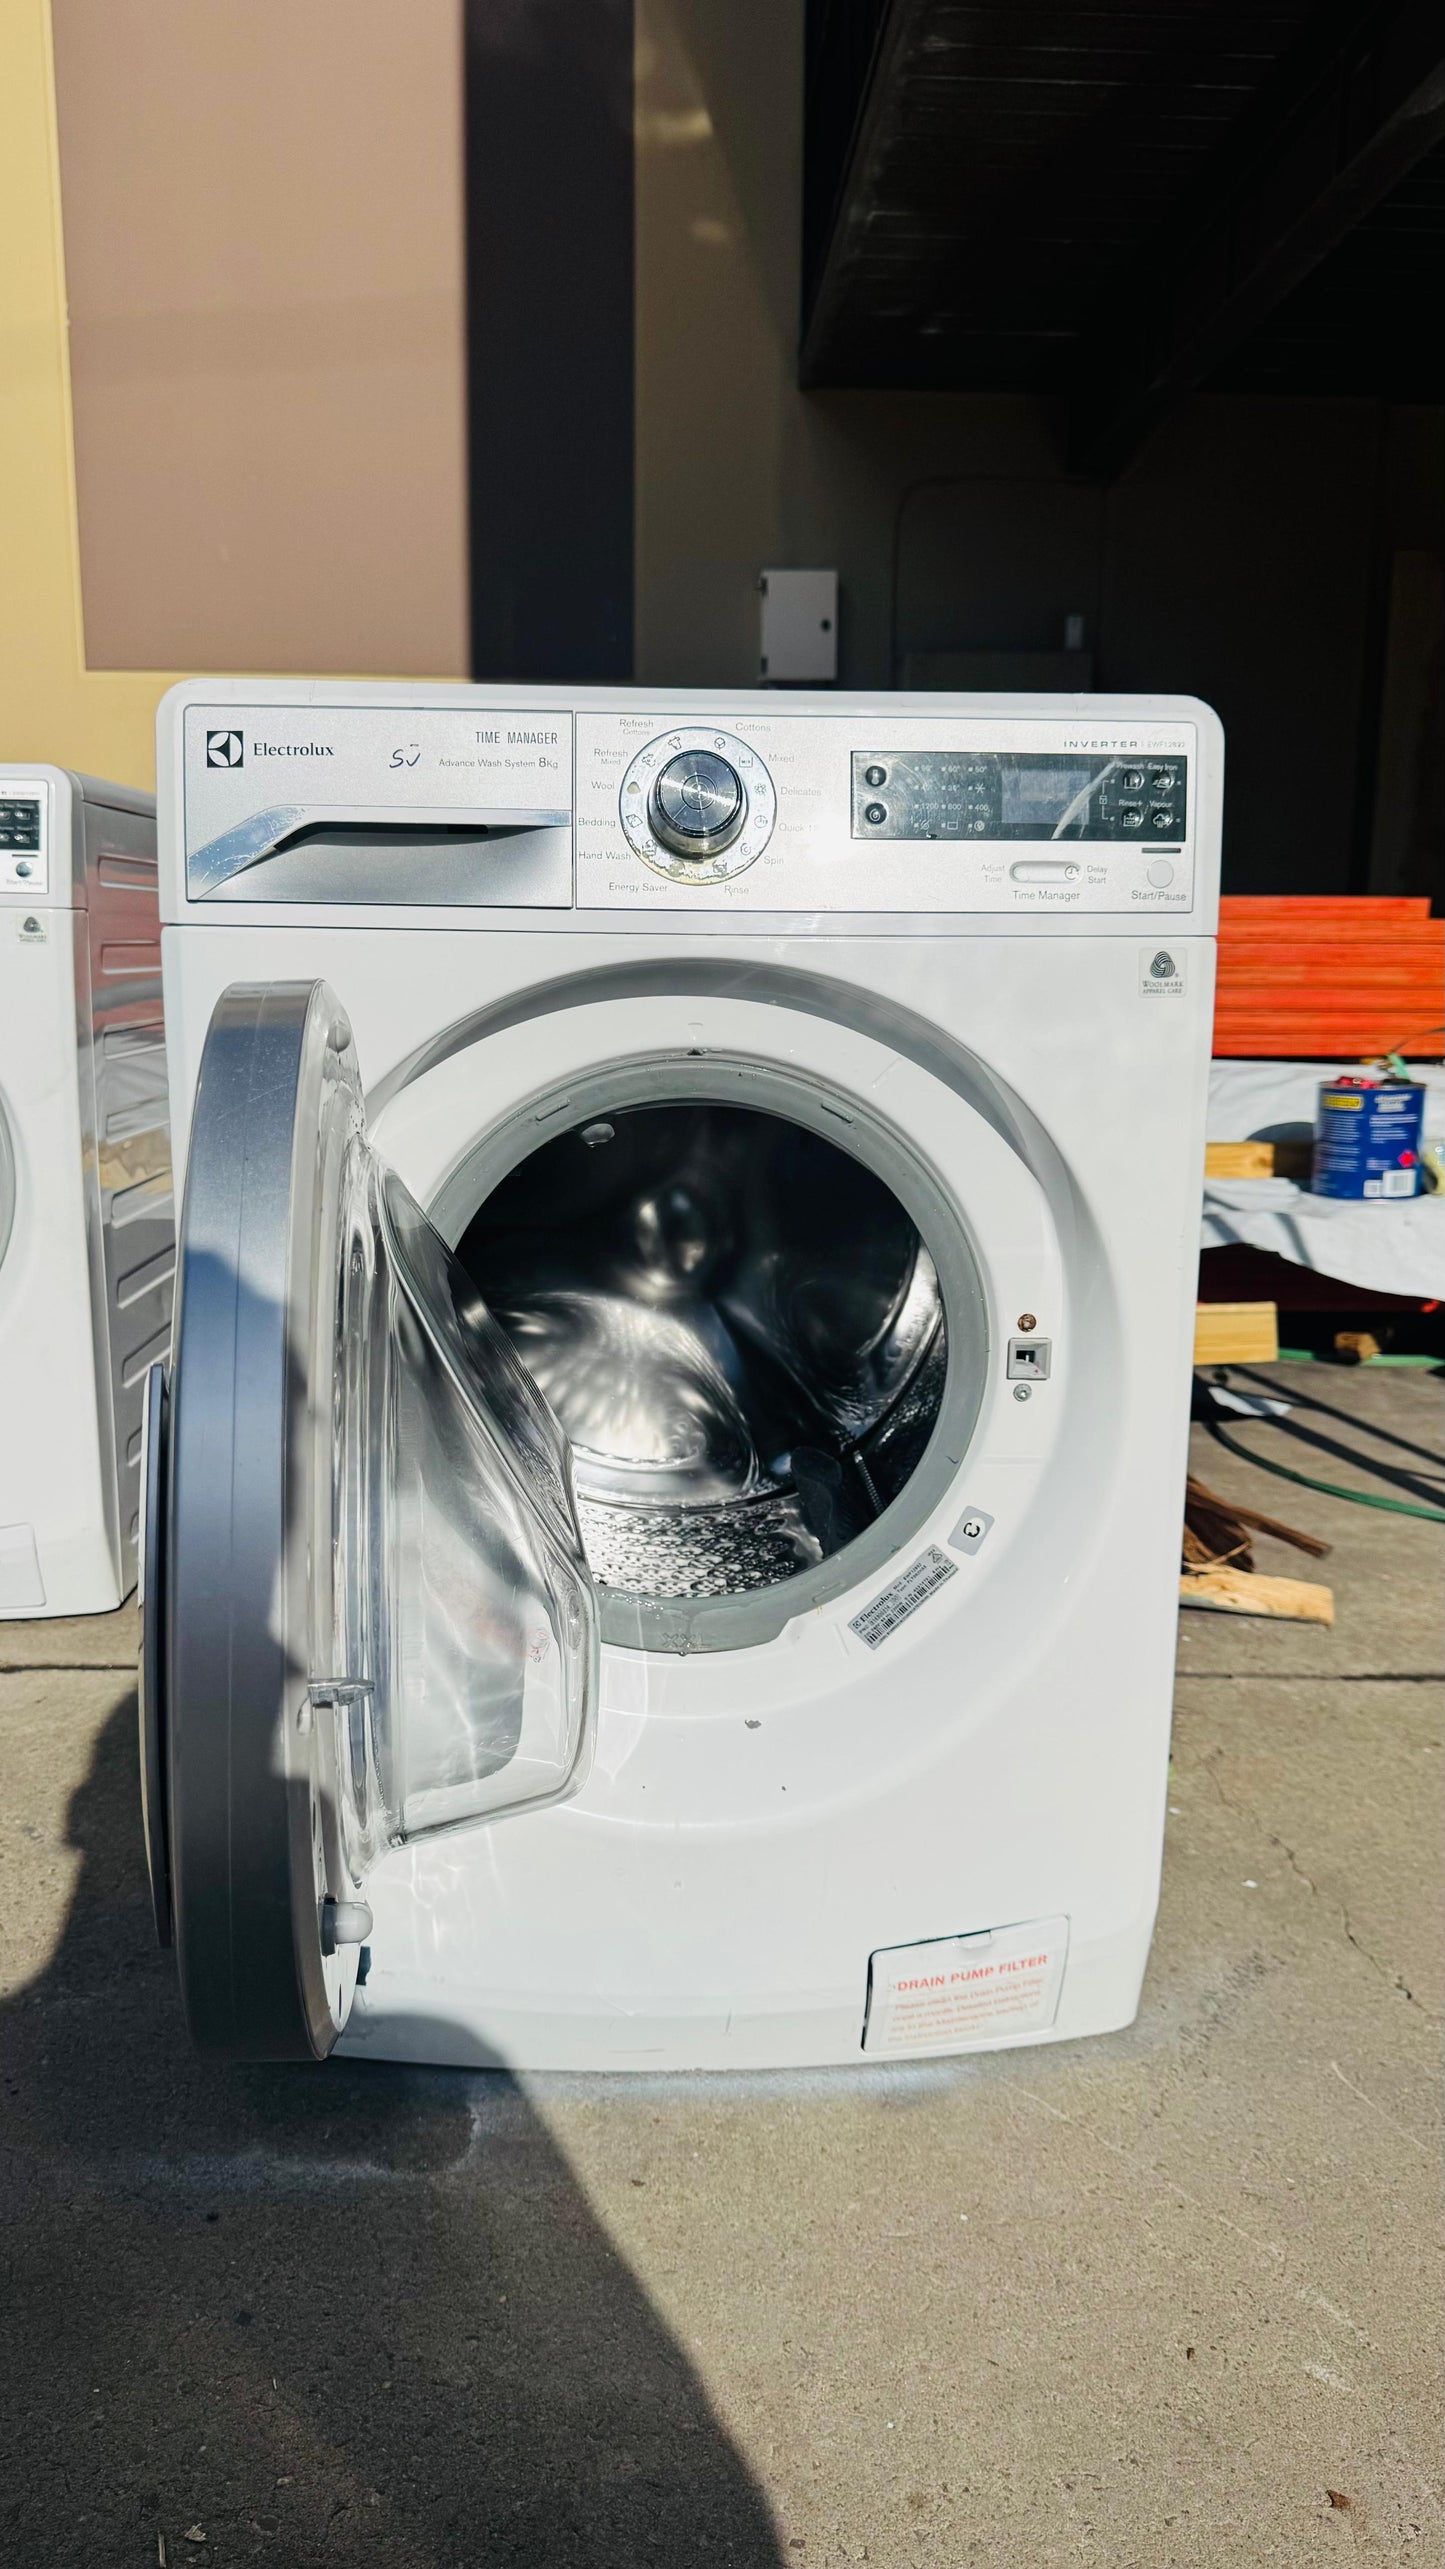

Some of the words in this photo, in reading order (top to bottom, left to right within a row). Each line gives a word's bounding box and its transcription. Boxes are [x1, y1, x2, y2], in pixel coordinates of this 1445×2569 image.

[619, 719, 654, 728] Refresh
[735, 722, 772, 731] Cottons
[475, 731, 501, 744] TIME
[507, 732, 558, 745] MANAGER
[1063, 740, 1138, 748] INVERTER
[253, 742, 335, 757] Electrolux
[593, 748, 629, 757] Refresh
[768, 754, 795, 763] Mixed
[438, 758, 475, 768] Advance
[477, 758, 502, 768] Wash
[504, 759, 536, 770] System
[538, 757, 559, 769] 8Kg
[591, 781, 615, 790] Wool
[780, 786, 822, 796] Delicates
[1149, 800, 1173, 808] Vapour
[578, 817, 616, 828] Bedding
[778, 823, 804, 832] Quick
[578, 851, 603, 860] Hand
[605, 851, 632, 860] Wash
[763, 856, 784, 866] Spin
[981, 864, 1005, 874] Adjust
[1086, 865, 1108, 875] Delay
[984, 875, 1003, 883] Time
[1087, 876, 1106, 884] Start
[608, 882, 640, 893] Energy
[642, 882, 668, 892] Saver
[724, 885, 749, 894] Rinse
[1012, 890, 1036, 900] Time
[1038, 890, 1080, 903] Manager
[1131, 890, 1187, 902] Start/Pause
[1142, 980, 1184, 988] WOOLMARK
[860, 1592, 894, 1623] Electrolux
[896, 1975, 945, 1992] DRAIN
[950, 1966, 996, 1984] PUMP
[998, 1954, 1048, 1974] FILTER
